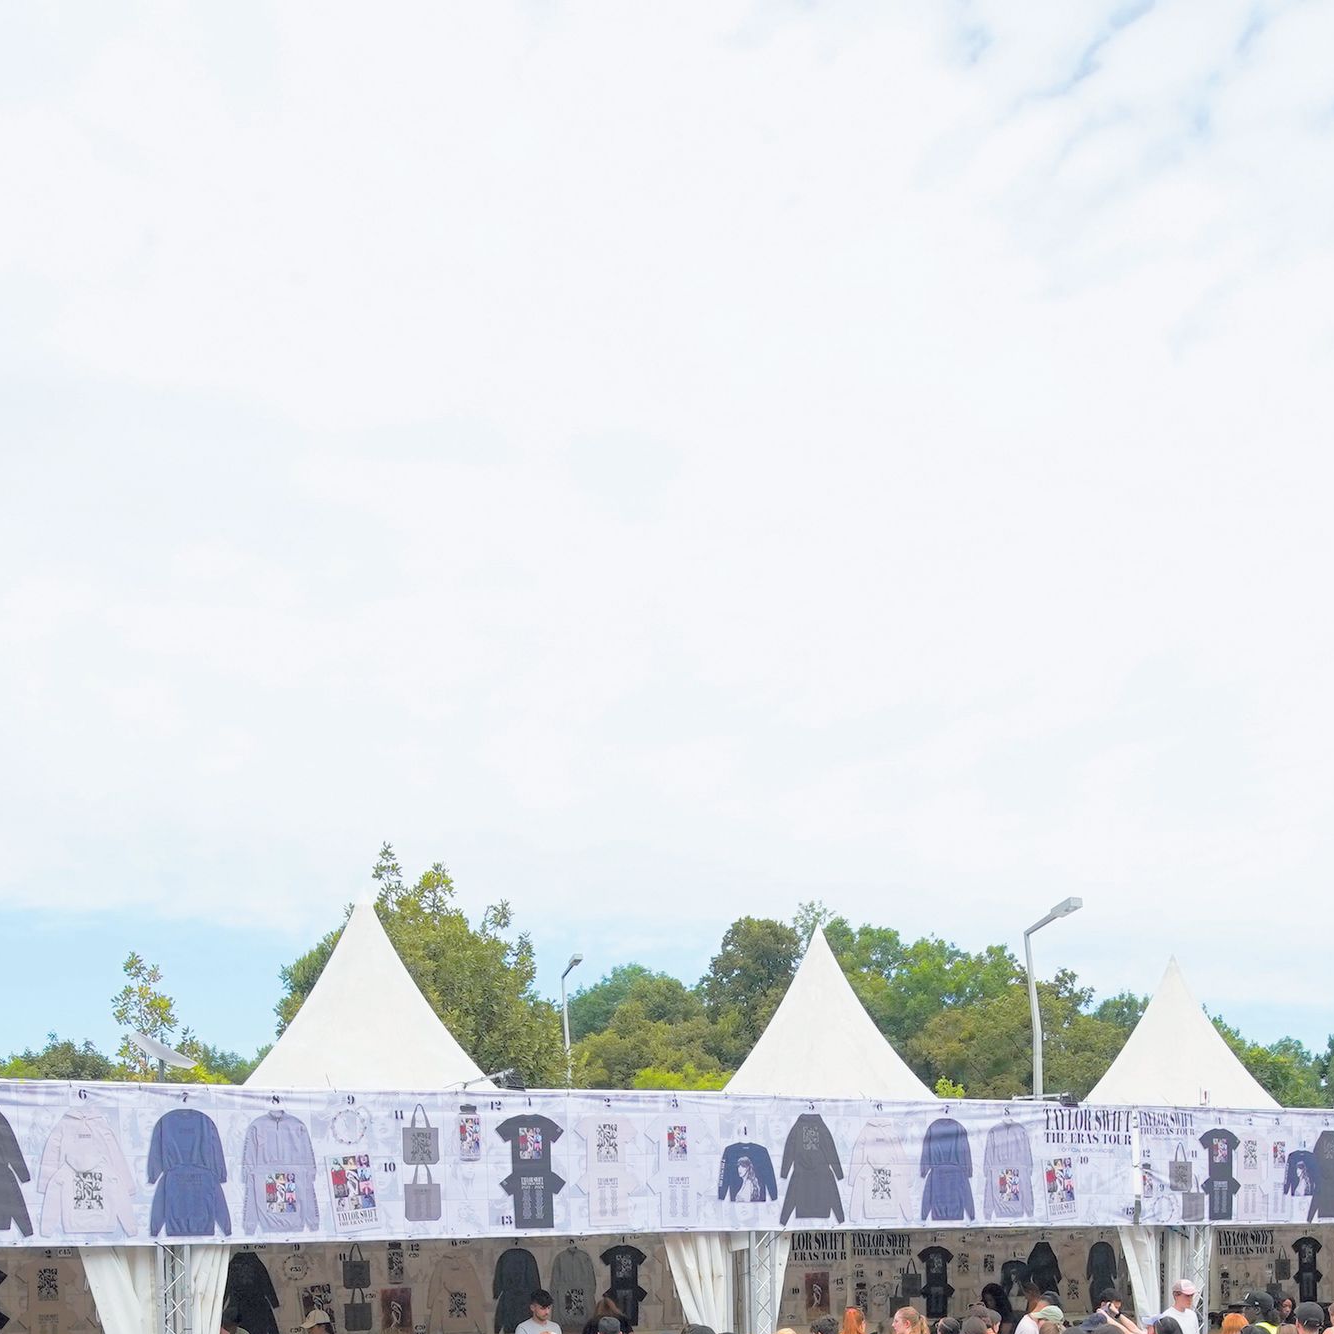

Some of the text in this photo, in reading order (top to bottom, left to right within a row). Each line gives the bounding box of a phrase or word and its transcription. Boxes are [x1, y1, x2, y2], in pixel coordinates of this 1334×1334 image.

[78, 1089, 87, 1099] 6
[181, 1092, 189, 1102] 7
[272, 1095, 280, 1104] 8
[347, 1095, 355, 1104] 9
[603, 1098, 611, 1107] 2
[490, 1101, 502, 1111] 12
[943, 1105, 950, 1114] 7
[394, 1110, 404, 1120] 11
[1139, 1111, 1194, 1127] TAYLOR SWIFT
[1042, 1108, 1133, 1133] TAYLOR SWIFT
[1155, 1127, 1174, 1135] ERAS
[1175, 1127, 1195, 1136] TOUR
[1043, 1132, 1132, 1146] THE ERAS TOUR
[384, 1162, 396, 1173] 10
[501, 1215, 513, 1226] 13
[791, 1232, 847, 1251] LOR SWIFT
[851, 1233, 912, 1248] TAYLOR SWIFT
[1218, 1229, 1275, 1247] TAYLOR SWIFT
[339, 1253, 346, 1261] 11
[794, 1251, 847, 1261] ERAS TOUR
[892, 1248, 912, 1256] TOUR
